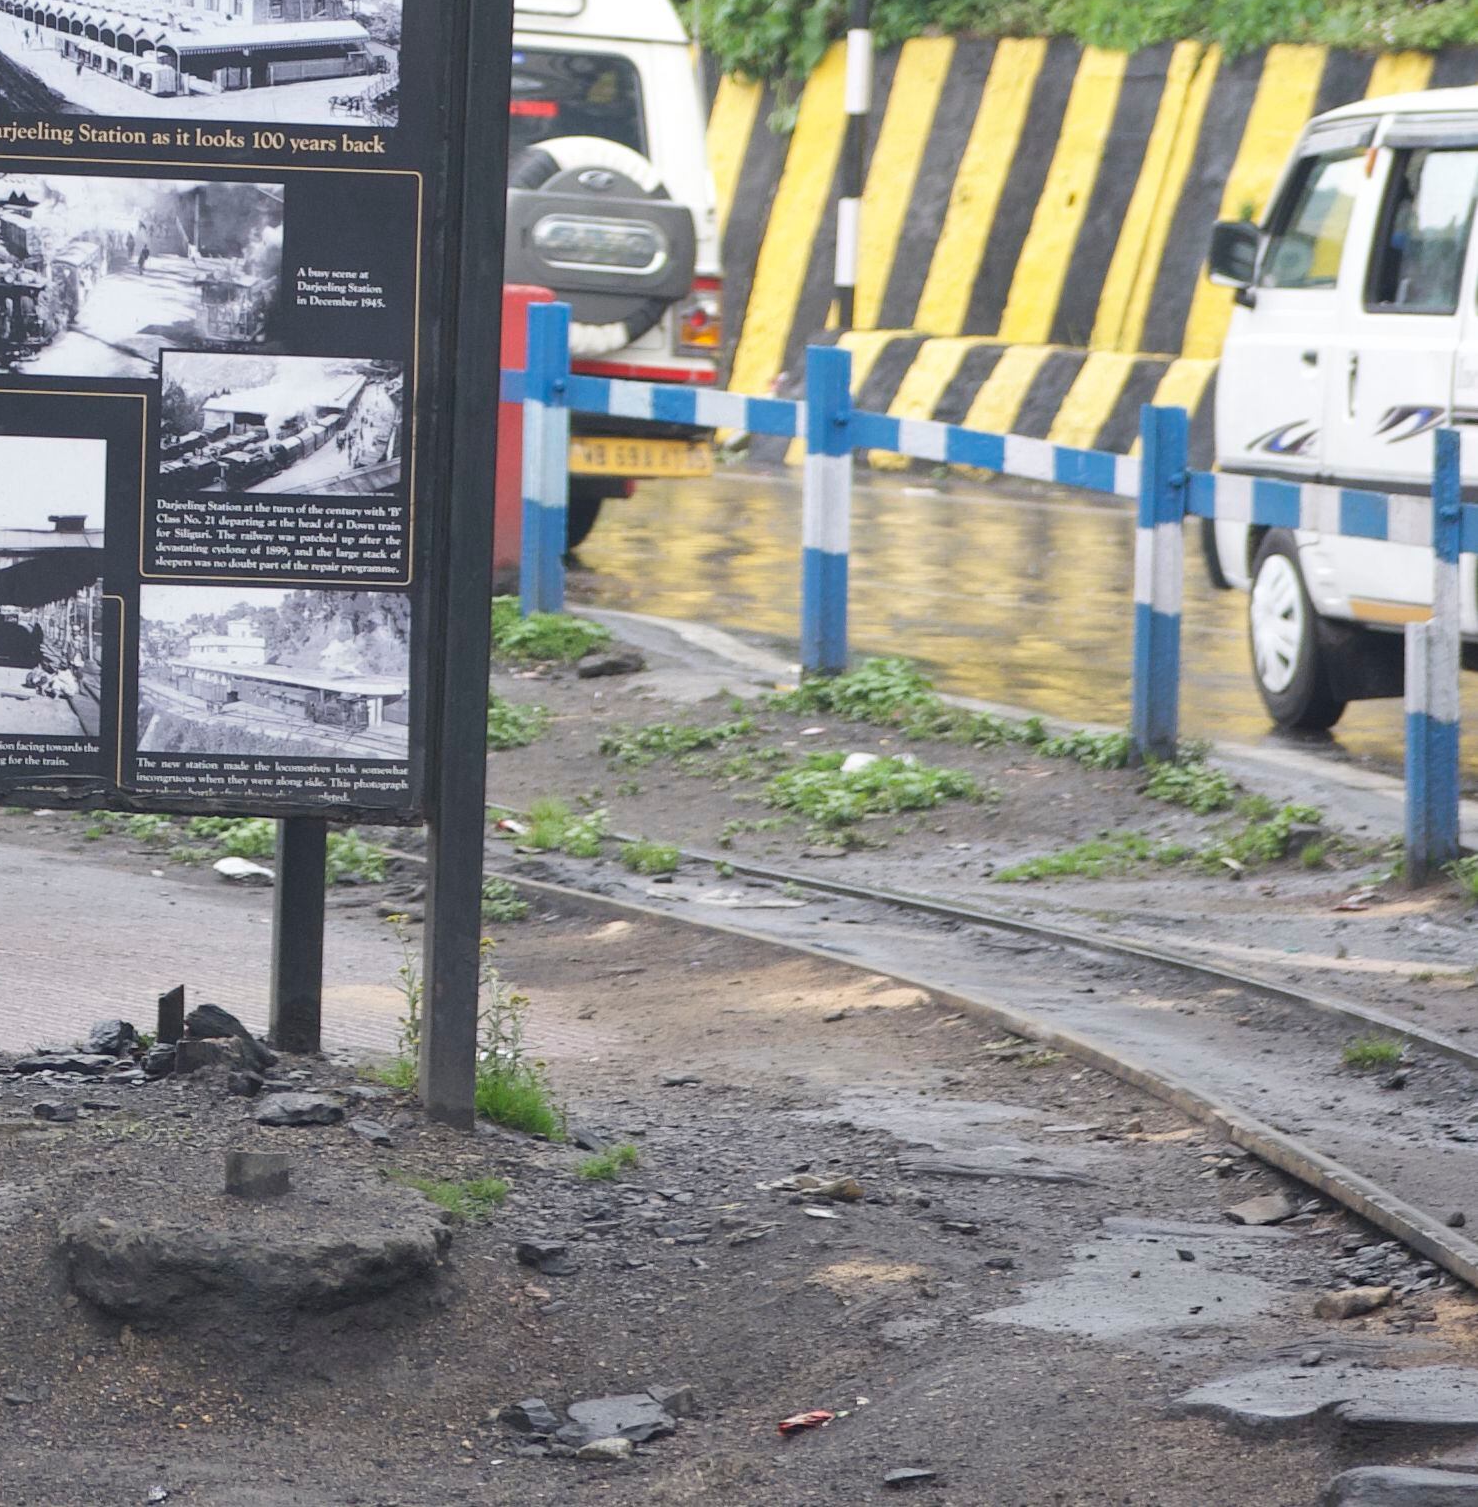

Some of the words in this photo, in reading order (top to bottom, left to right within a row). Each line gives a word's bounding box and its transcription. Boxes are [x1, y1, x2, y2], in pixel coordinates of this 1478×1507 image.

[79, 124, 146, 145] Station
[152, 132, 171, 146] as
[176, 129, 190, 147] it
[195, 128, 245, 149] looks
[253, 132, 285, 150] 100
[290, 138, 338, 153] years
[342, 134, 386, 155] back
[296, 267, 306, 277] A
[308, 267, 330, 280] busy
[332, 271, 357, 279] scene
[297, 281, 347, 294] Darjeeling
[348, 282, 383, 294] Station
[296, 296, 308, 306] in
[310, 296, 358, 307] December
[361, 297, 387, 308] 1945.
[156, 499, 206, 512] Darjeeling
[207, 500, 242, 511] Station
[243, 503, 253, 512] at
[255, 502, 271, 513] the
[272, 505, 294, 514] turn
[296, 504, 307, 514] of
[308, 504, 324, 515] the
[325, 506, 363, 517] century
[364, 506, 386, 517] with
[156, 513, 181, 524] Class
[183, 514, 202, 525] No.
[204, 515, 216, 525] 21
[218, 515, 265, 528] departing
[267, 519, 277, 527] at
[279, 517, 296, 528] the
[298, 518, 322, 529] head
[324, 519, 335, 529] of
[337, 521, 343, 529] a
[346, 520, 375, 531] Down
[377, 522, 402, 532] train
[155, 528, 171, 538] for
[174, 528, 213, 541] Siliguri.
[215, 530, 236, 540] The
[240, 531, 274, 542] railway
[278, 534, 296, 542] was
[300, 533, 337, 544] patched
[341, 535, 355, 546] up
[358, 534, 381, 545] after
[385, 535, 402, 546] the
[155, 542, 209, 555] devastating
[211, 544, 247, 555] cyclone
[250, 545, 261, 554] of
[294, 547, 313, 557] and
[316, 547, 333, 558] the
[336, 548, 359, 559] large
[363, 549, 387, 559] stack
[390, 549, 402, 560] of
[154, 556, 192, 569] sleepers
[194, 559, 212, 568] was
[213, 560, 227, 569] no
[228, 558, 257, 570] doubt
[258, 561, 279, 571] part
[281, 560, 292, 570] of
[293, 560, 310, 571] the
[311, 562, 340, 573] repair
[342, 564, 400, 575] programme.
[16, 740, 45, 753] facing
[46, 742, 83, 753] towards
[84, 742, 100, 753] the
[8, 755, 23, 765] for
[24, 755, 41, 765] the
[42, 757, 69, 766] train.
[136, 757, 157, 768] The
[161, 760, 181, 768] new
[185, 760, 219, 770] station
[223, 761, 250, 771] made
[254, 761, 270, 772] the
[275, 761, 331, 773] locomotives
[335, 763, 357, 774] look
[361, 764, 409, 775] somewhat
[136, 772, 196, 784] incongruous
[198, 774, 225, 784] when
[227, 774, 249, 786] they
[250, 778, 274, 786] were
[275, 776, 303, 788] along
[304, 777, 327, 788] side.
[329, 778, 351, 788] This
[353, 778, 409, 791] photograph
